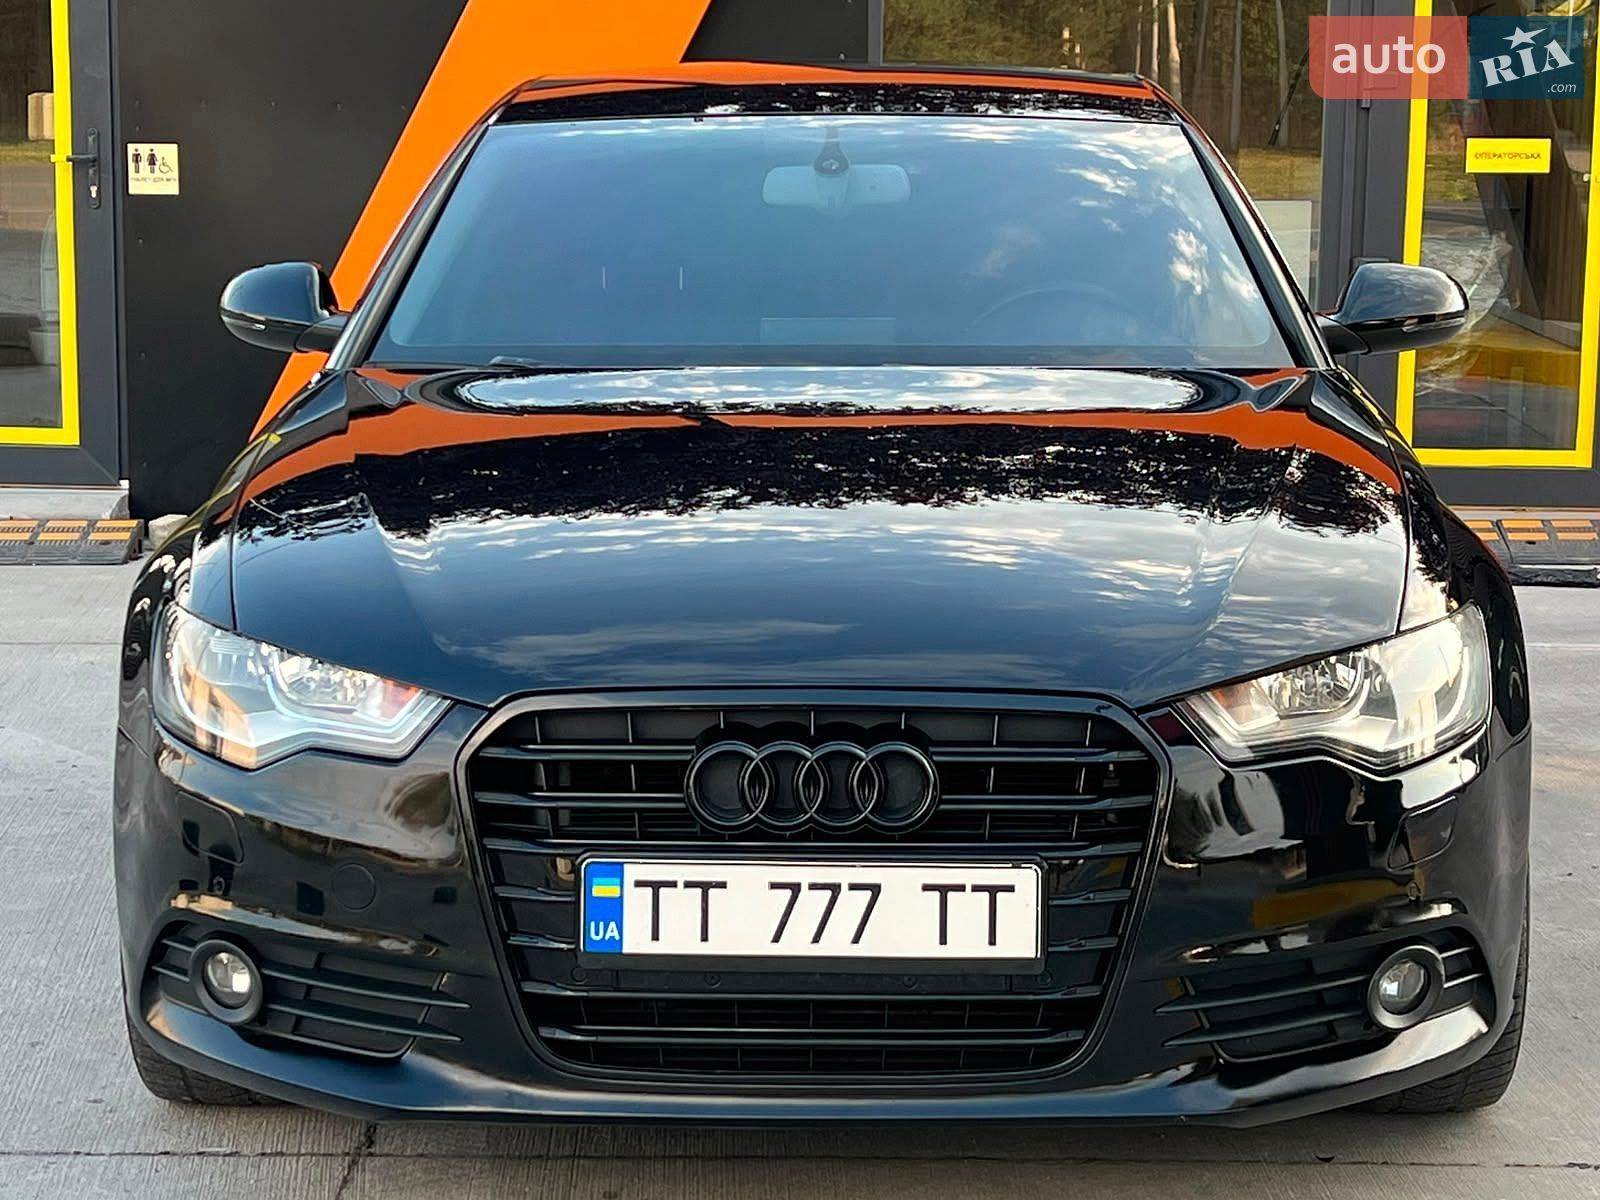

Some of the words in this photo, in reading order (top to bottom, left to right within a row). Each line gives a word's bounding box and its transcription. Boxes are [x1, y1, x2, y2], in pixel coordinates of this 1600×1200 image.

[1474, 151, 1542, 160] ОПЕРАТОРСЬКА
[633, 879, 728, 943] TT
[768, 881, 882, 945] 777
[921, 882, 1016, 946] TT
[589, 920, 621, 942] UA
